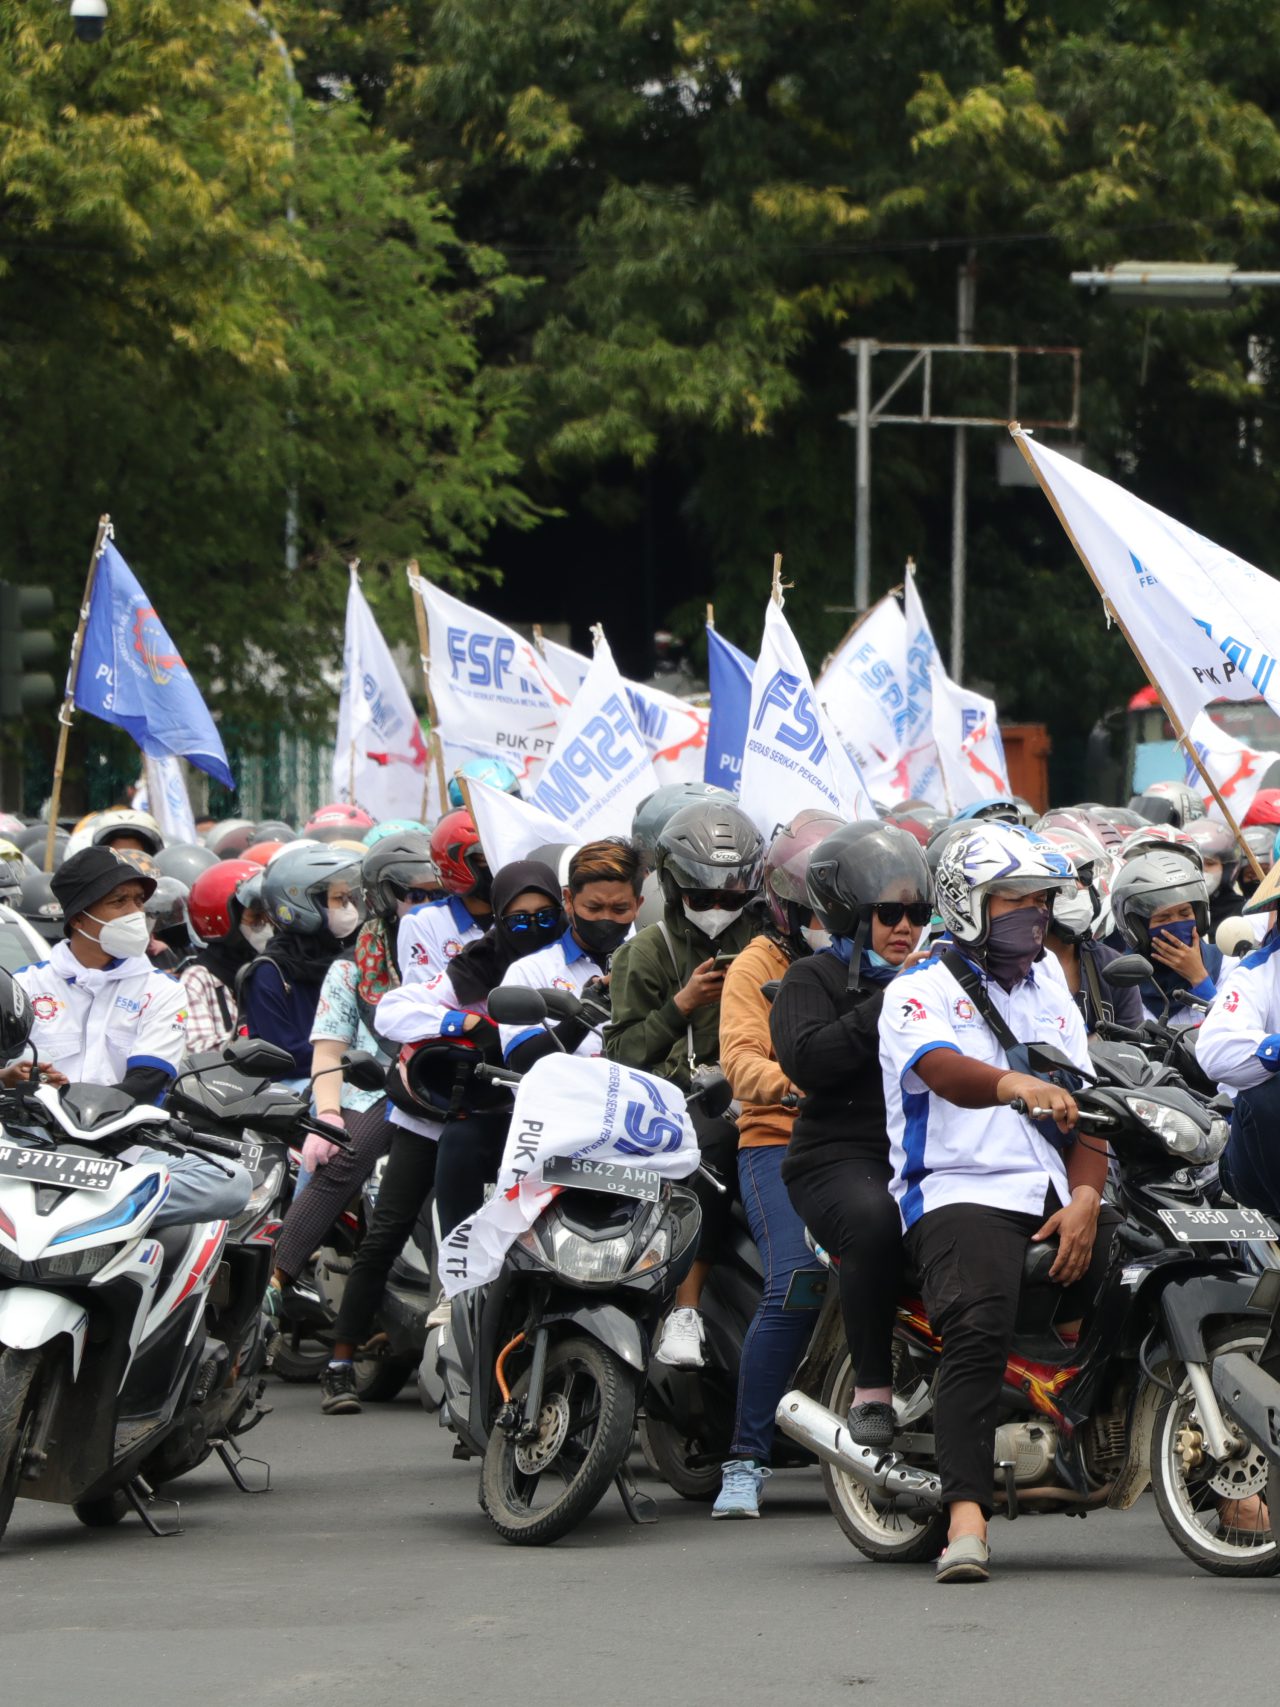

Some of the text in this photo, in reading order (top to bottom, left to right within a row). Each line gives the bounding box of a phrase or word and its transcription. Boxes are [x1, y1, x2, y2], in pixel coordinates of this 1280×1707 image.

[496, 732, 528, 750] PUK
[769, 749, 799, 771] SERIKAT
[797, 766, 830, 796] PEKERJA
[602, 1099, 618, 1128] SERIKAT
[514, 1119, 543, 1162] PUK
[579, 1127, 612, 1155] PEKERJA
[18, 1151, 67, 1168] 3717
[74, 1160, 114, 1176] ANW
[571, 1160, 616, 1177] 5642
[1161, 1210, 1263, 1224] H 5850 CY
